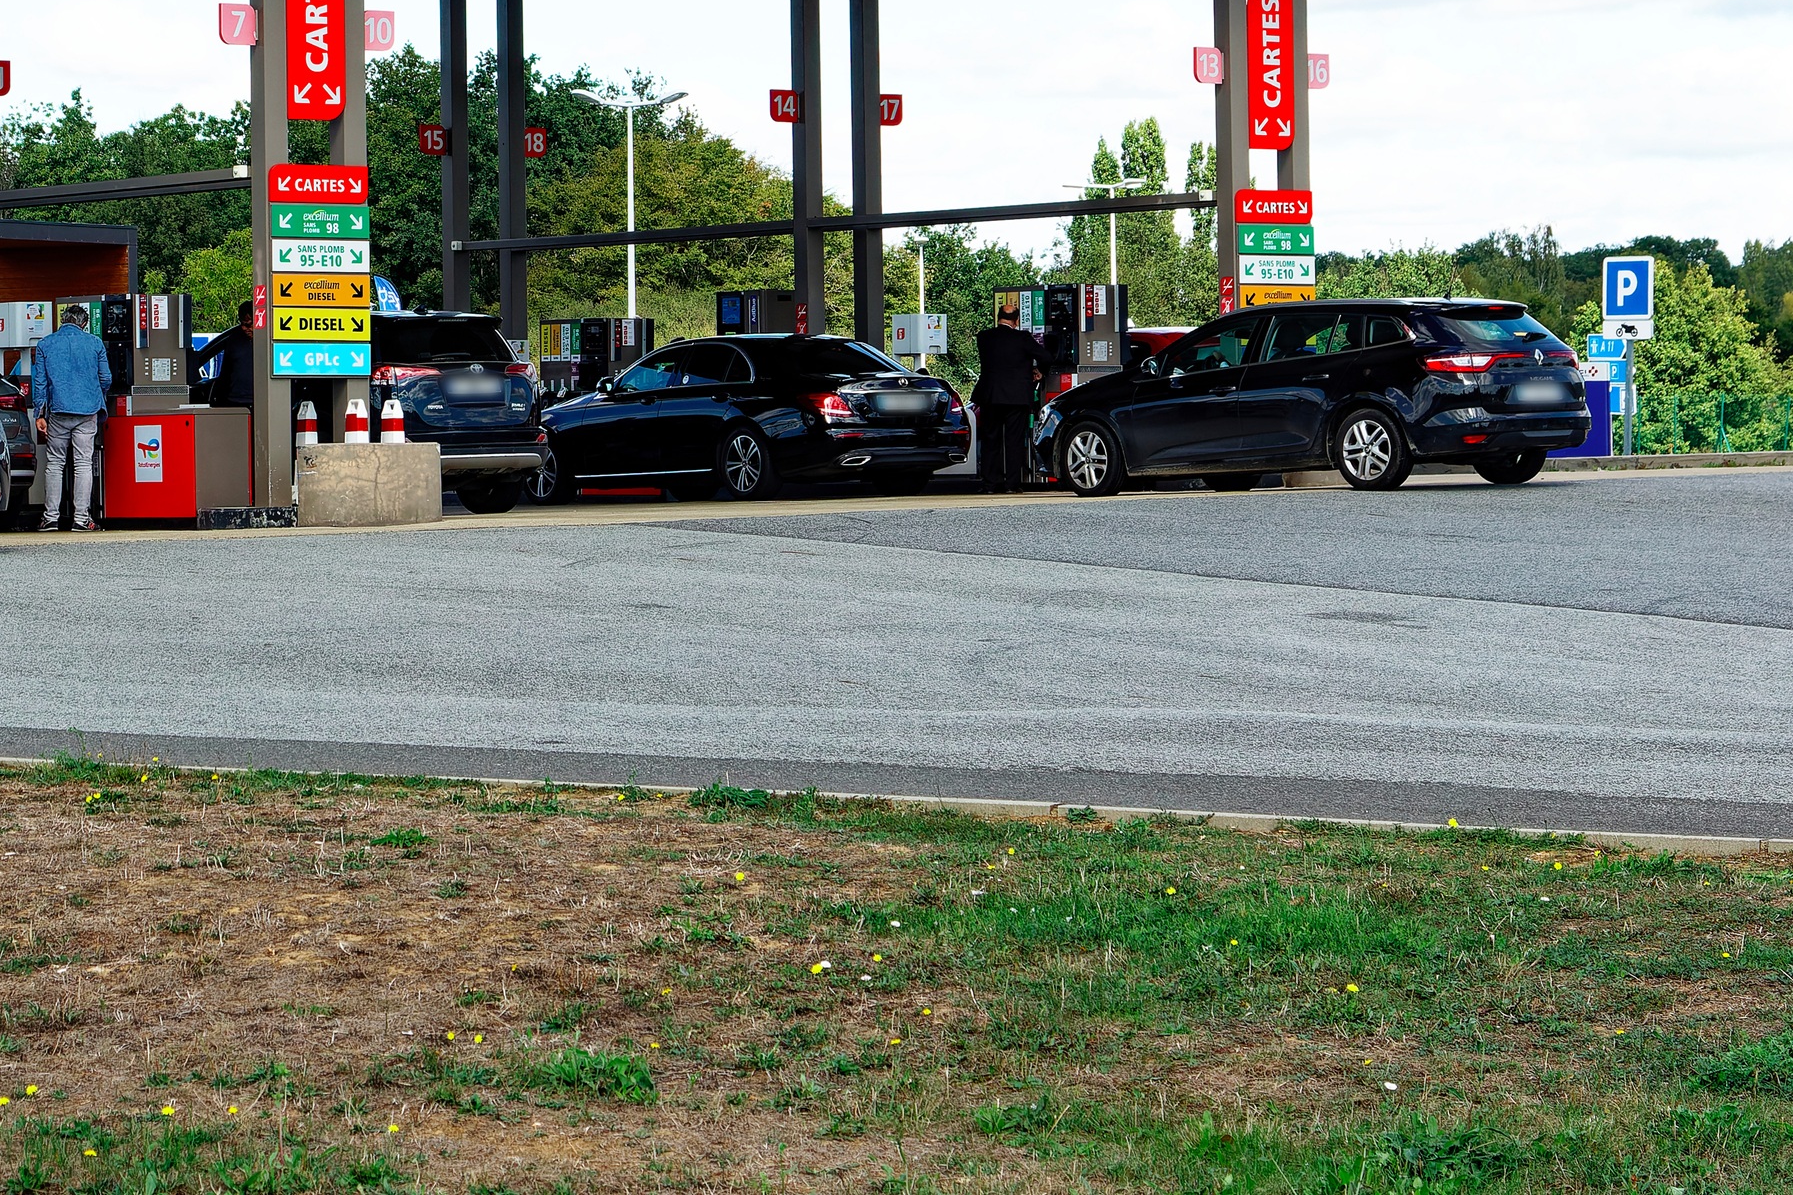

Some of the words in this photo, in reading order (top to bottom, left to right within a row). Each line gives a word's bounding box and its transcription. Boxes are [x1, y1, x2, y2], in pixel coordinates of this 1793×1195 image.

[231, 10, 246, 37] 7
[365, 17, 392, 44] 10
[1199, 53, 1220, 78] 13
[1308, 58, 1328, 84] 16
[774, 95, 796, 116] 14
[879, 98, 901, 121] 17
[423, 130, 444, 151] 15
[524, 132, 544, 153] 18
[295, 178, 345, 193] CARTES
[1255, 202, 1296, 214] CARTES
[303, 211, 339, 222] excellium
[326, 223, 339, 234] 98
[298, 245, 317, 253] SANS
[319, 245, 345, 254] PLOMB
[1281, 240, 1291, 251] 98
[300, 255, 342, 267] 95-E10
[1261, 268, 1294, 279] 95-E10
[304, 280, 340, 290] excellium
[1617, 270, 1638, 307] P
[308, 292, 336, 301] DIESEL
[299, 317, 345, 331] DIESEL
[1600, 342, 1605, 352] A
[304, 352, 340, 366] GPLc
[1612, 367, 1618, 376] P
